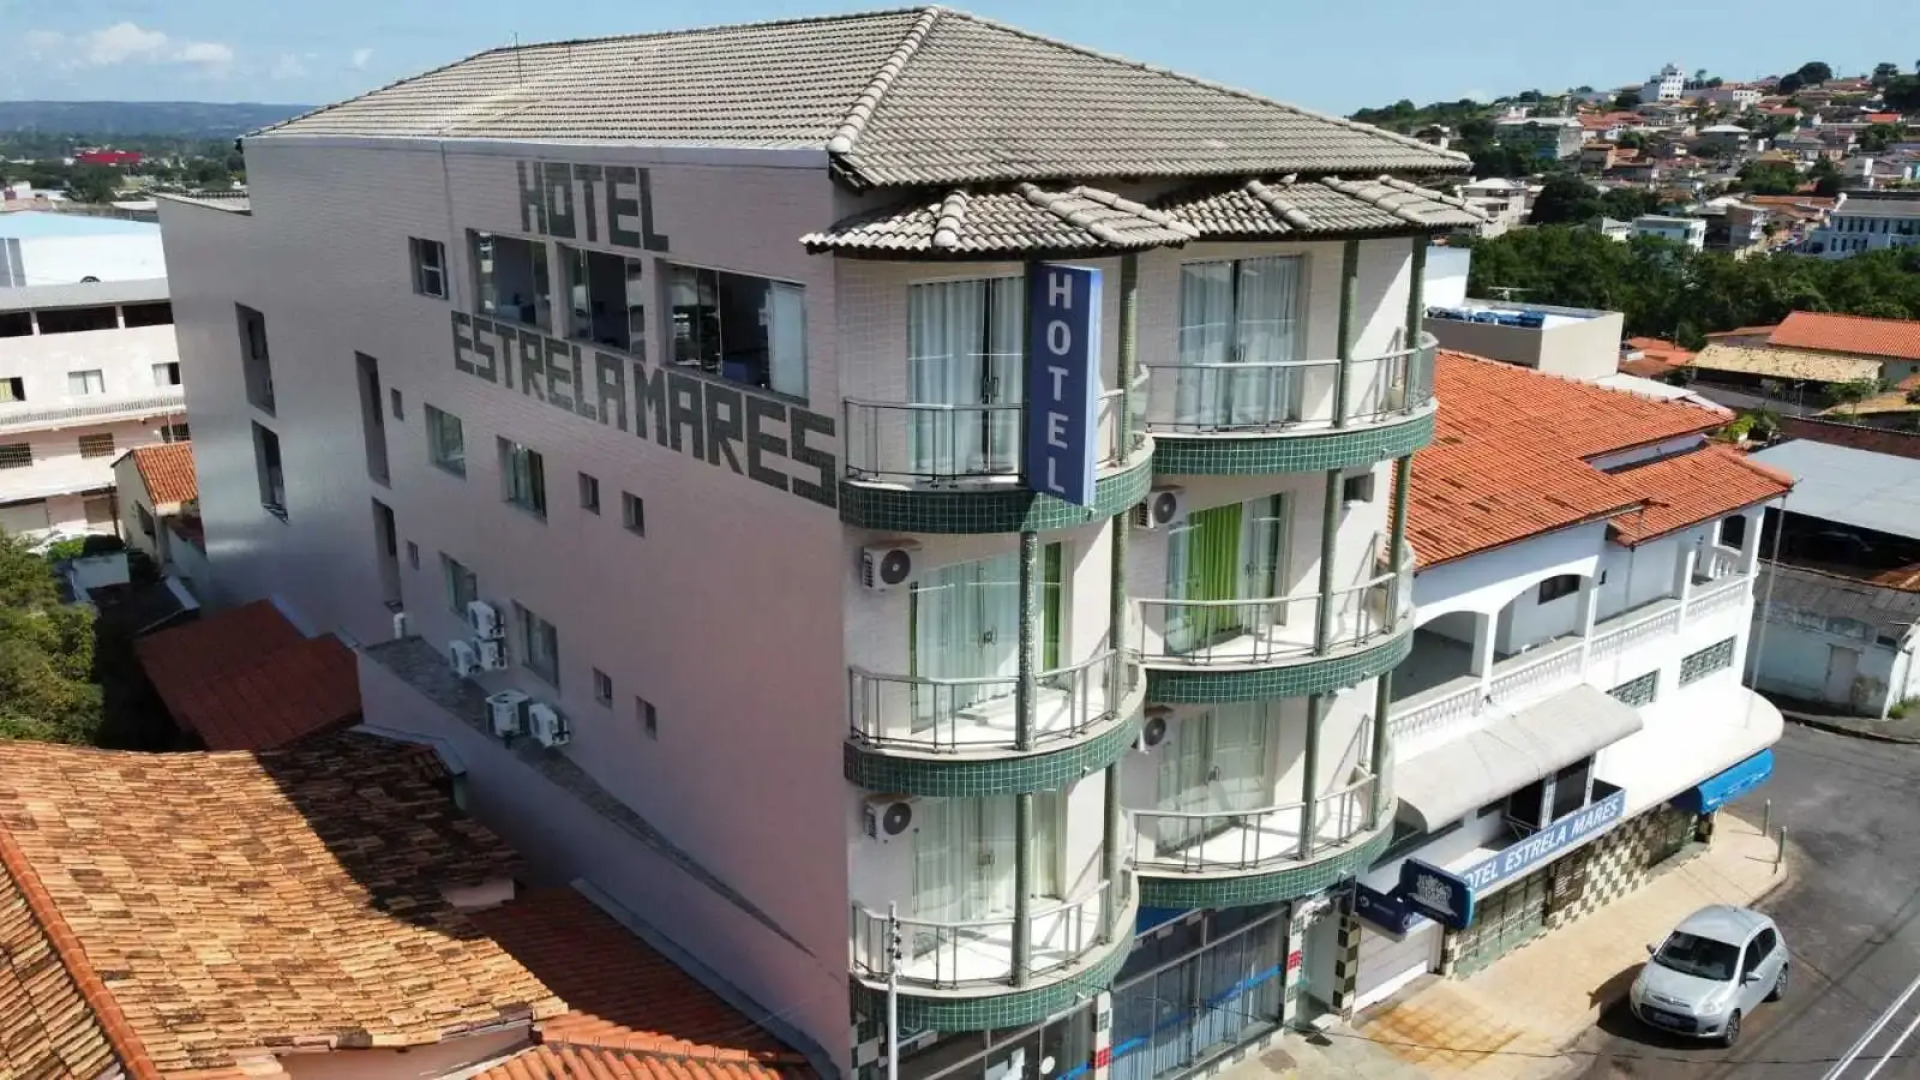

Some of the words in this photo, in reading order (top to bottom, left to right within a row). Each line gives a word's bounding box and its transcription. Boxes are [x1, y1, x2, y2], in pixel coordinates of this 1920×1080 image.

[517, 161, 669, 252] HOTEL
[451, 310, 628, 432] ESTRELA
[633, 363, 837, 510] MARES
[1046, 272, 1073, 494] HOTEL
[1504, 826, 1566, 872] ESTRELA
[1571, 798, 1619, 837] MARES
